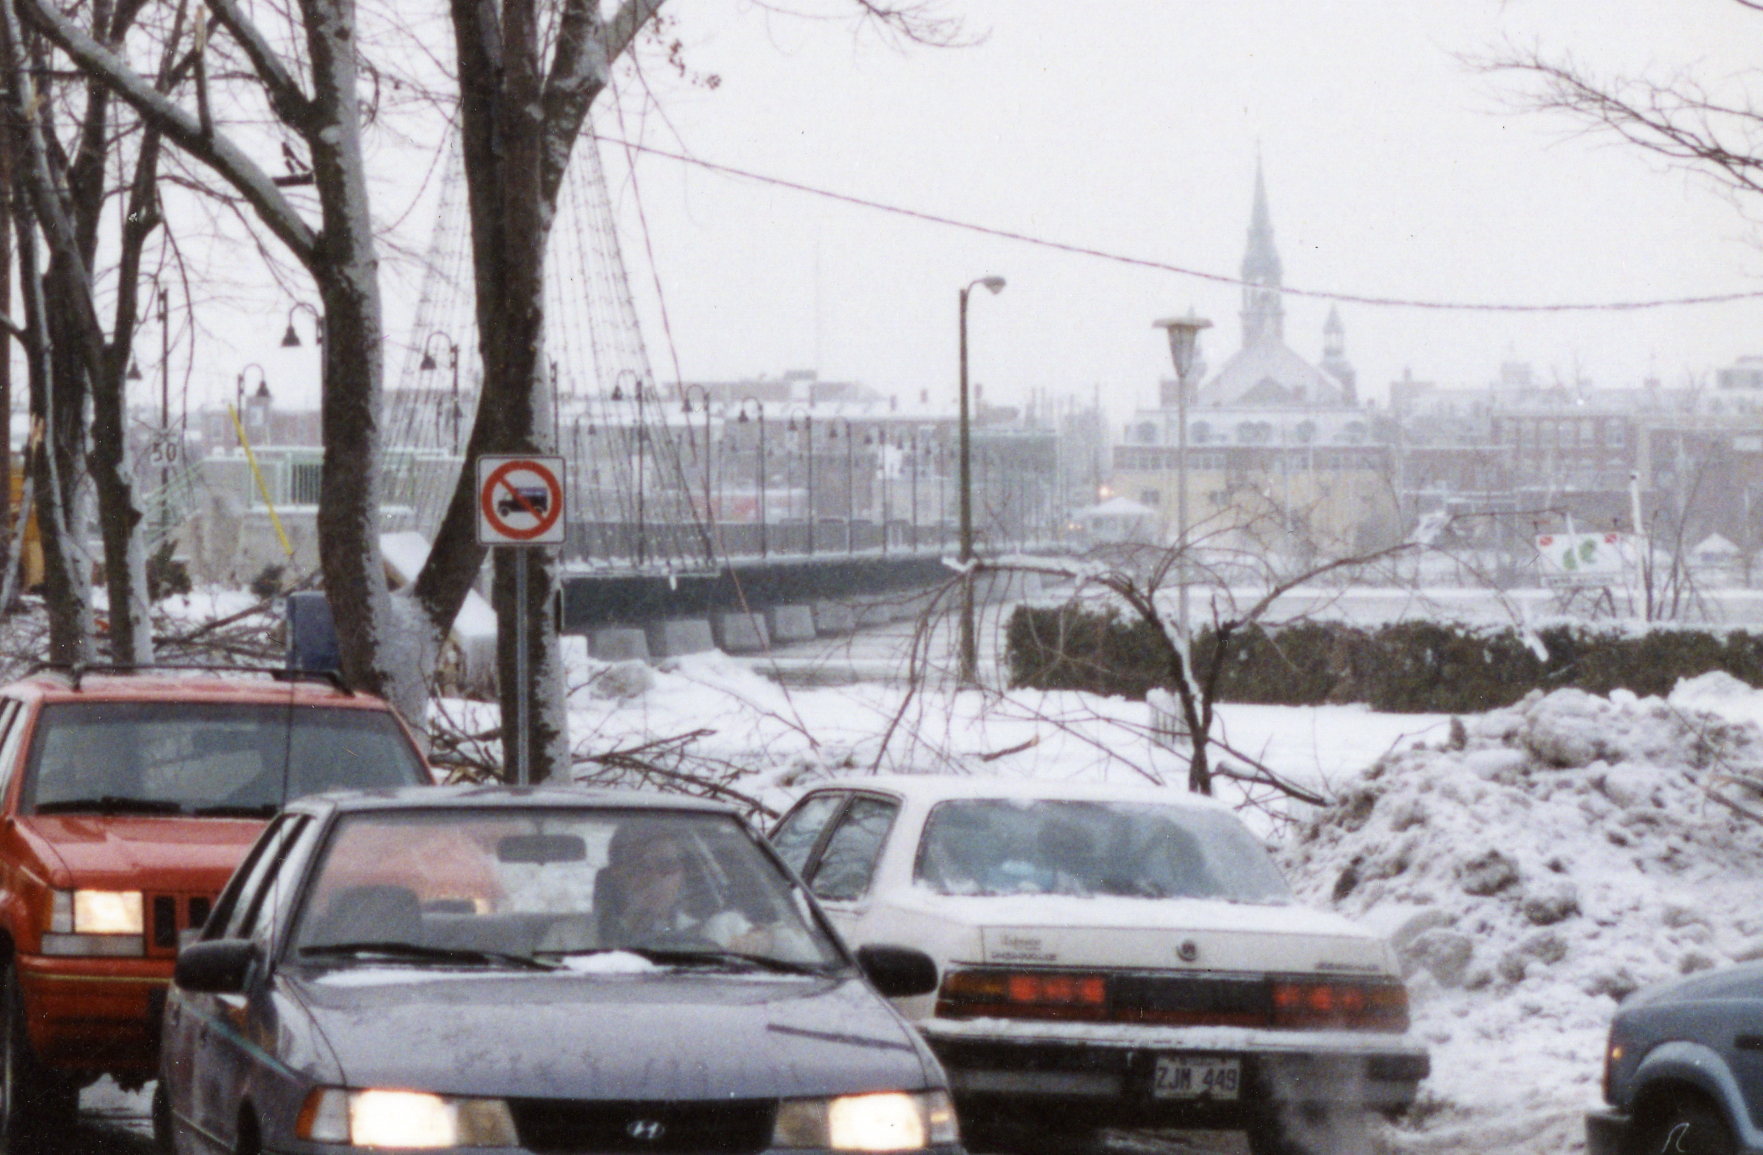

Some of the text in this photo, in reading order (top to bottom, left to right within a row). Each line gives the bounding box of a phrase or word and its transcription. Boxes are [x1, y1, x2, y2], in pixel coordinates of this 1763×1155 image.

[153, 442, 177, 463] 50
[1156, 1066, 1238, 1091] ZJM 449
